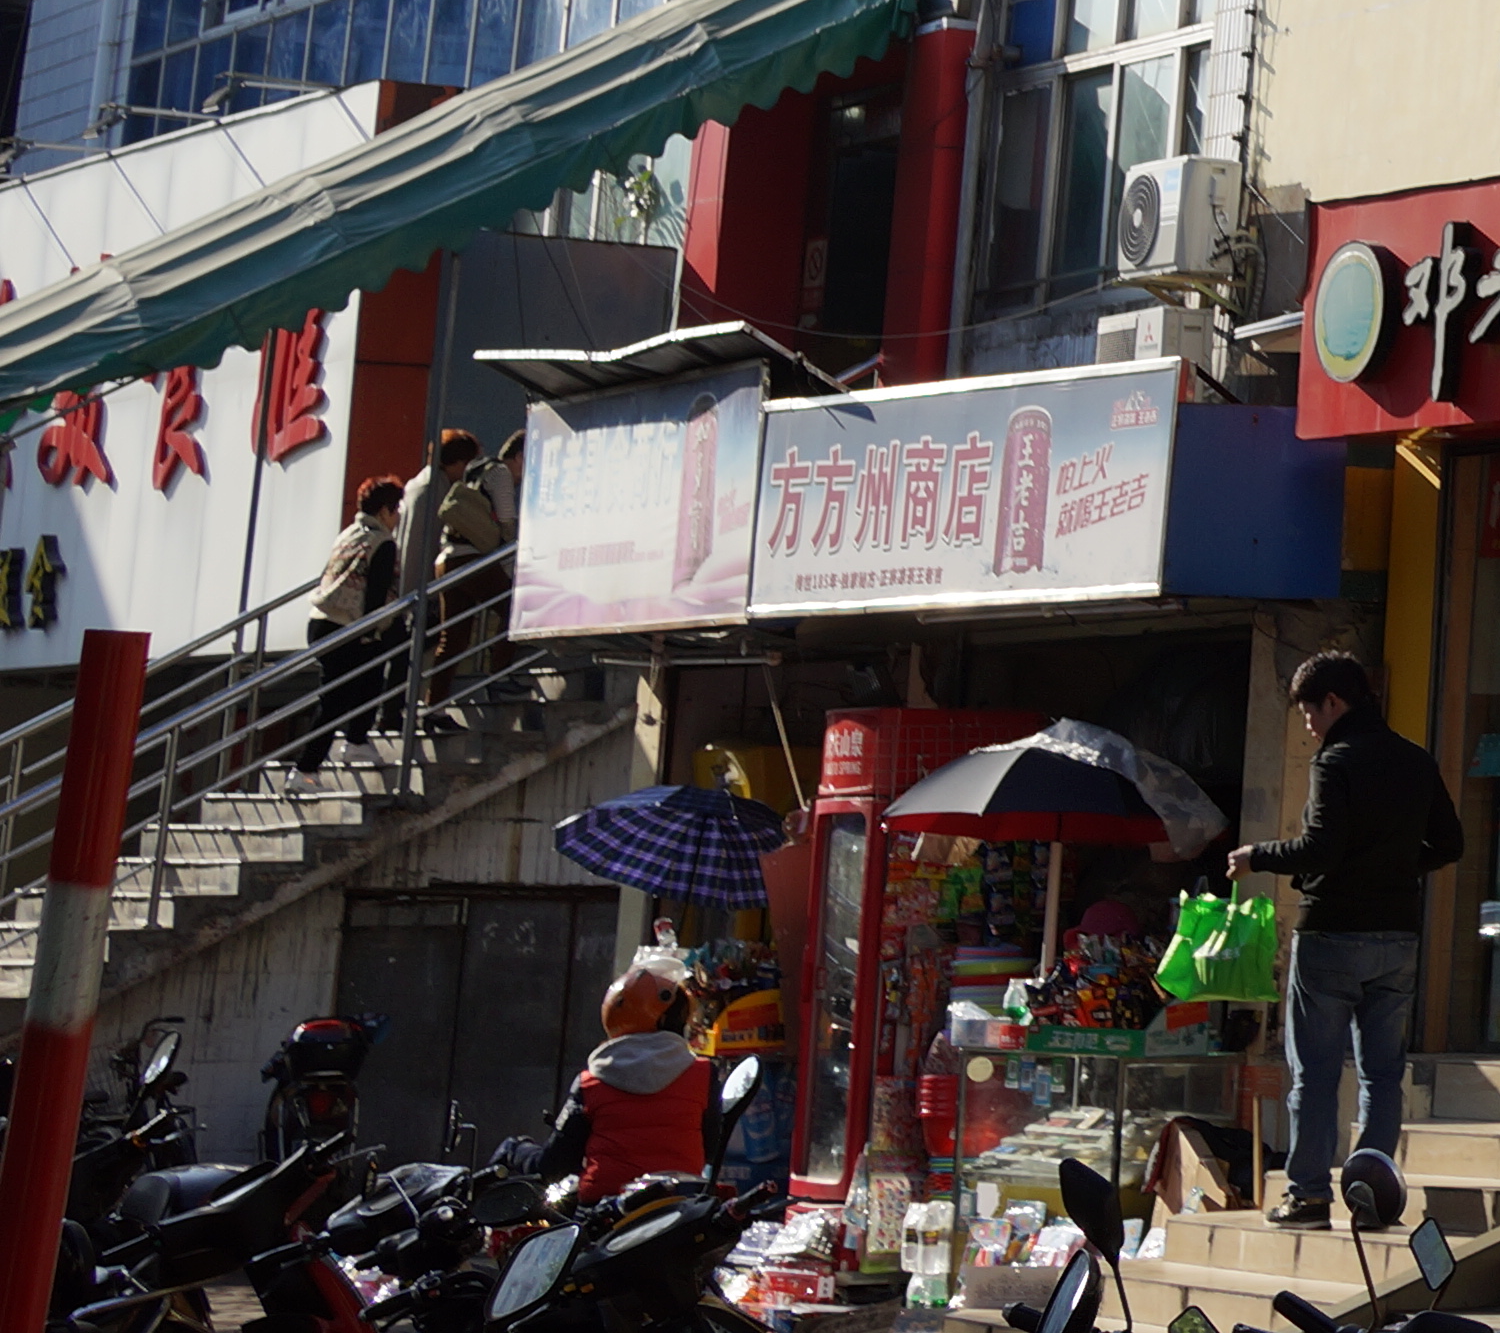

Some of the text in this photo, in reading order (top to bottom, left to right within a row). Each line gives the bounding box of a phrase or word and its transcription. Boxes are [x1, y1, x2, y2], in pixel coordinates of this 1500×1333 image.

[768, 431, 993, 556] 方方州商店
[1010, 433, 1035, 553] 王老吉
[1055, 442, 1114, 496] 怕上火
[1055, 473, 1150, 539] 就喝王老吉
